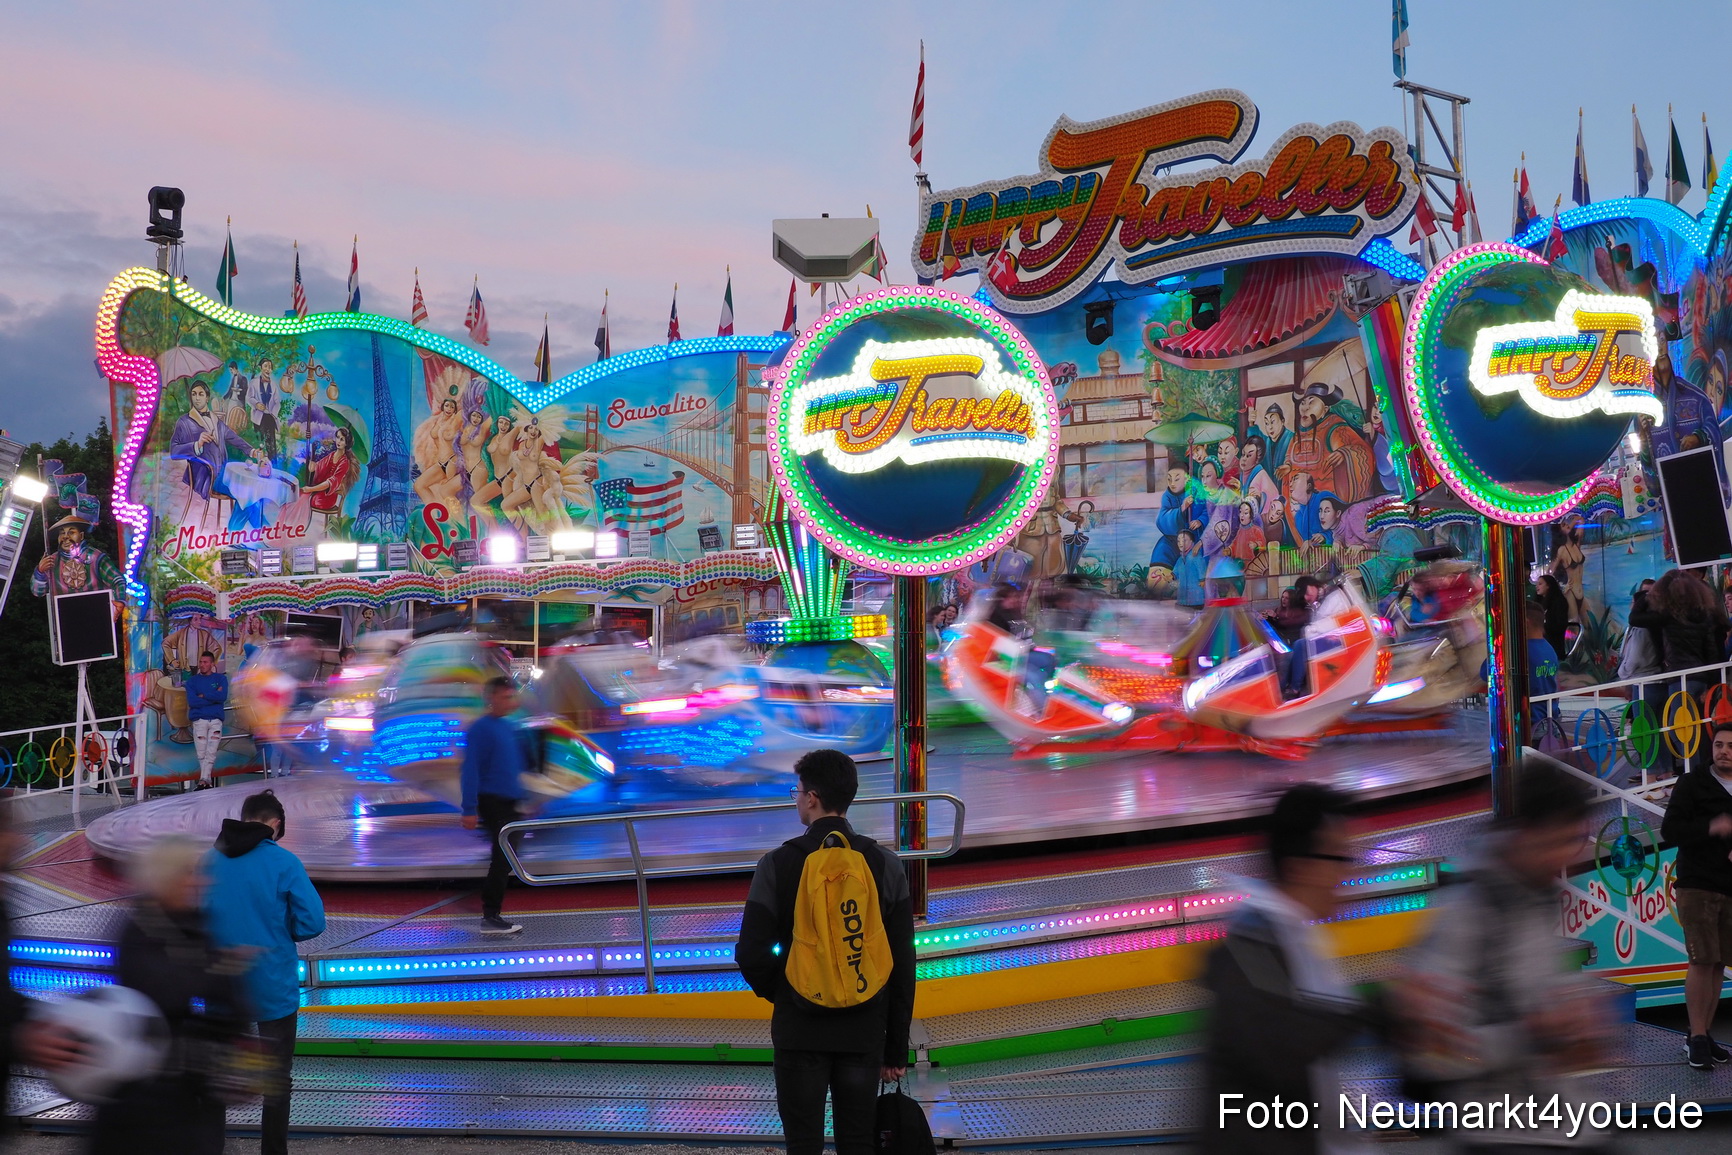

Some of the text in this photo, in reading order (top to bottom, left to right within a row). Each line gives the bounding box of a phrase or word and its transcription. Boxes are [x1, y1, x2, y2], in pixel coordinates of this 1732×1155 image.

[919, 99, 1407, 301] HAPPY Traveller
[1487, 333, 1598, 385] HAPPY
[607, 393, 707, 429] Sausalito
[802, 382, 898, 438] HAPPY
[161, 521, 306, 560] Montmartre
[1560, 882, 1608, 937] Paris
[839, 898, 868, 993] adidas
